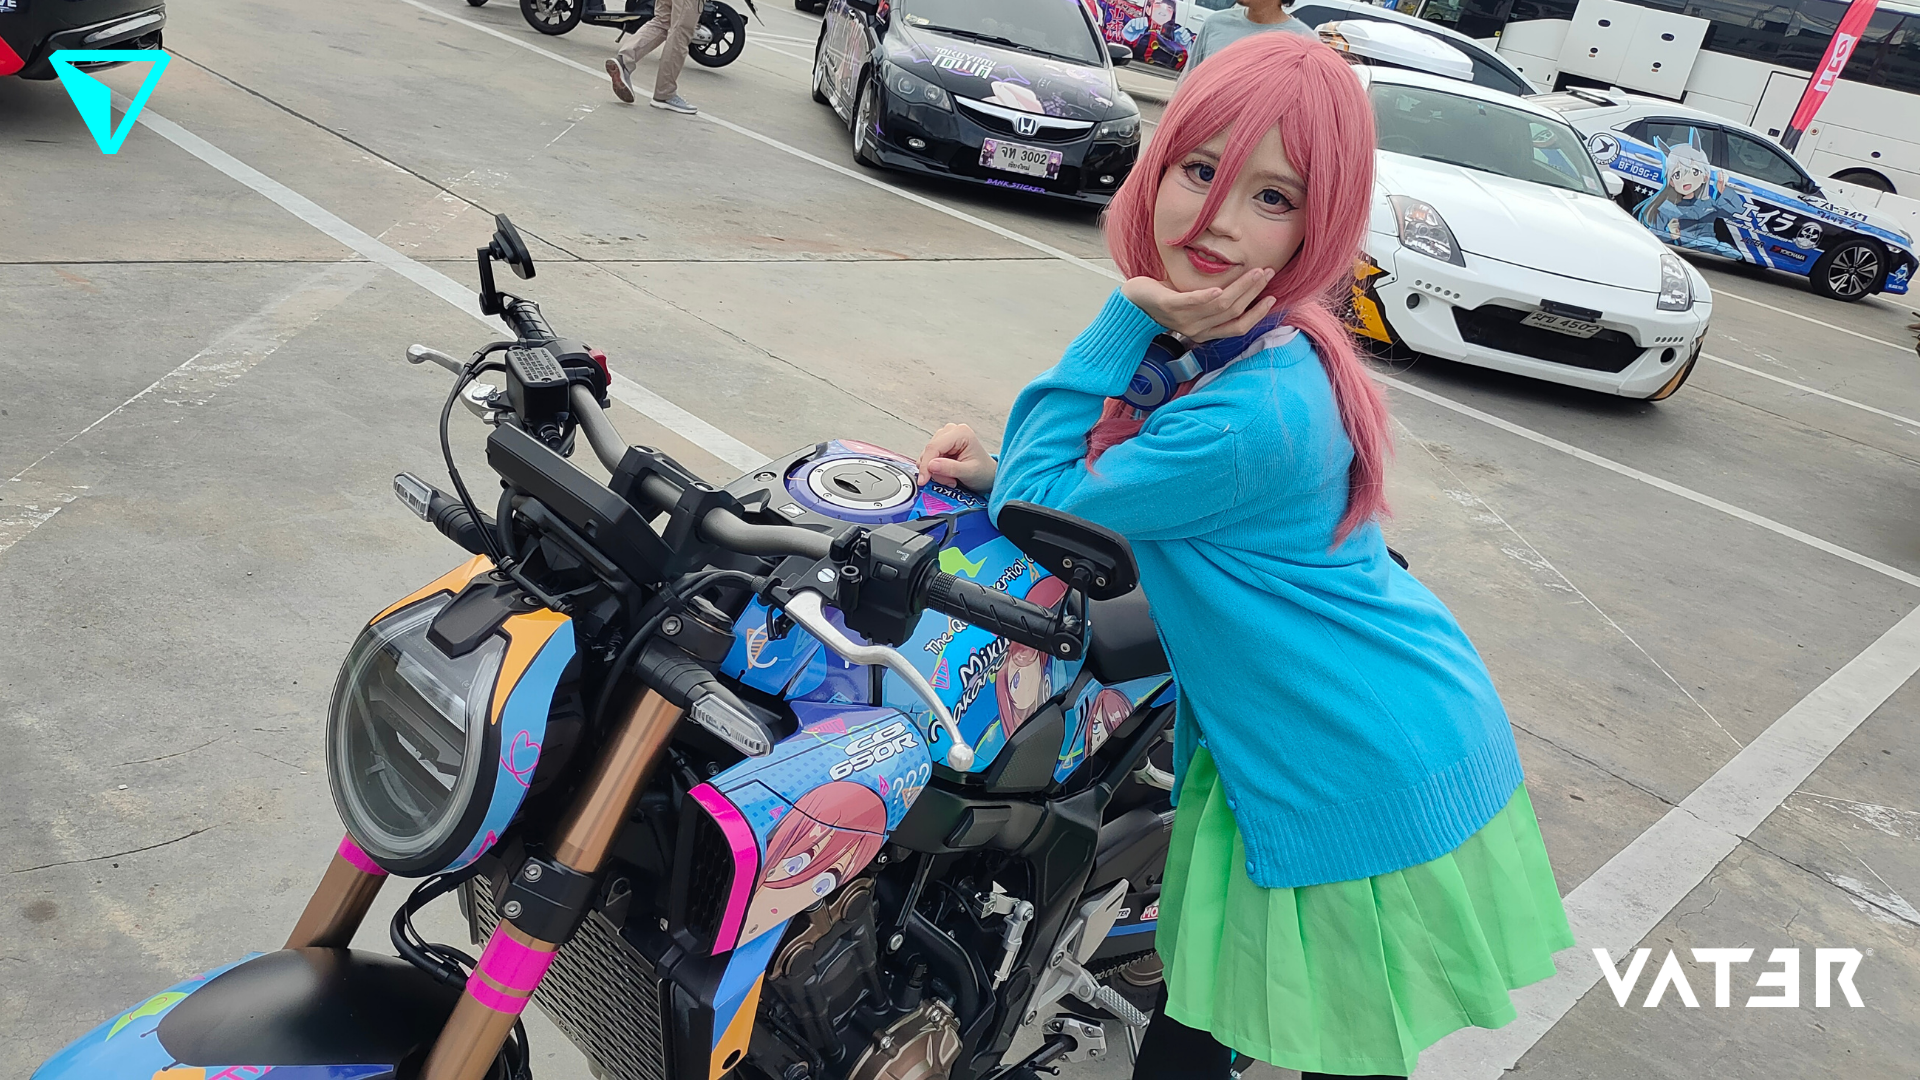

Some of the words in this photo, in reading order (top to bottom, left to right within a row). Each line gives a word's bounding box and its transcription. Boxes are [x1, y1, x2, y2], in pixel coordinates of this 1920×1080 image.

[1020, 150, 1047, 165] 3002
[1732, 202, 1797, 232] エイラ
[1559, 319, 1600, 334] 4502
[924, 632, 953, 654] The
[844, 721, 906, 757] CB
[829, 732, 920, 781] 650R
